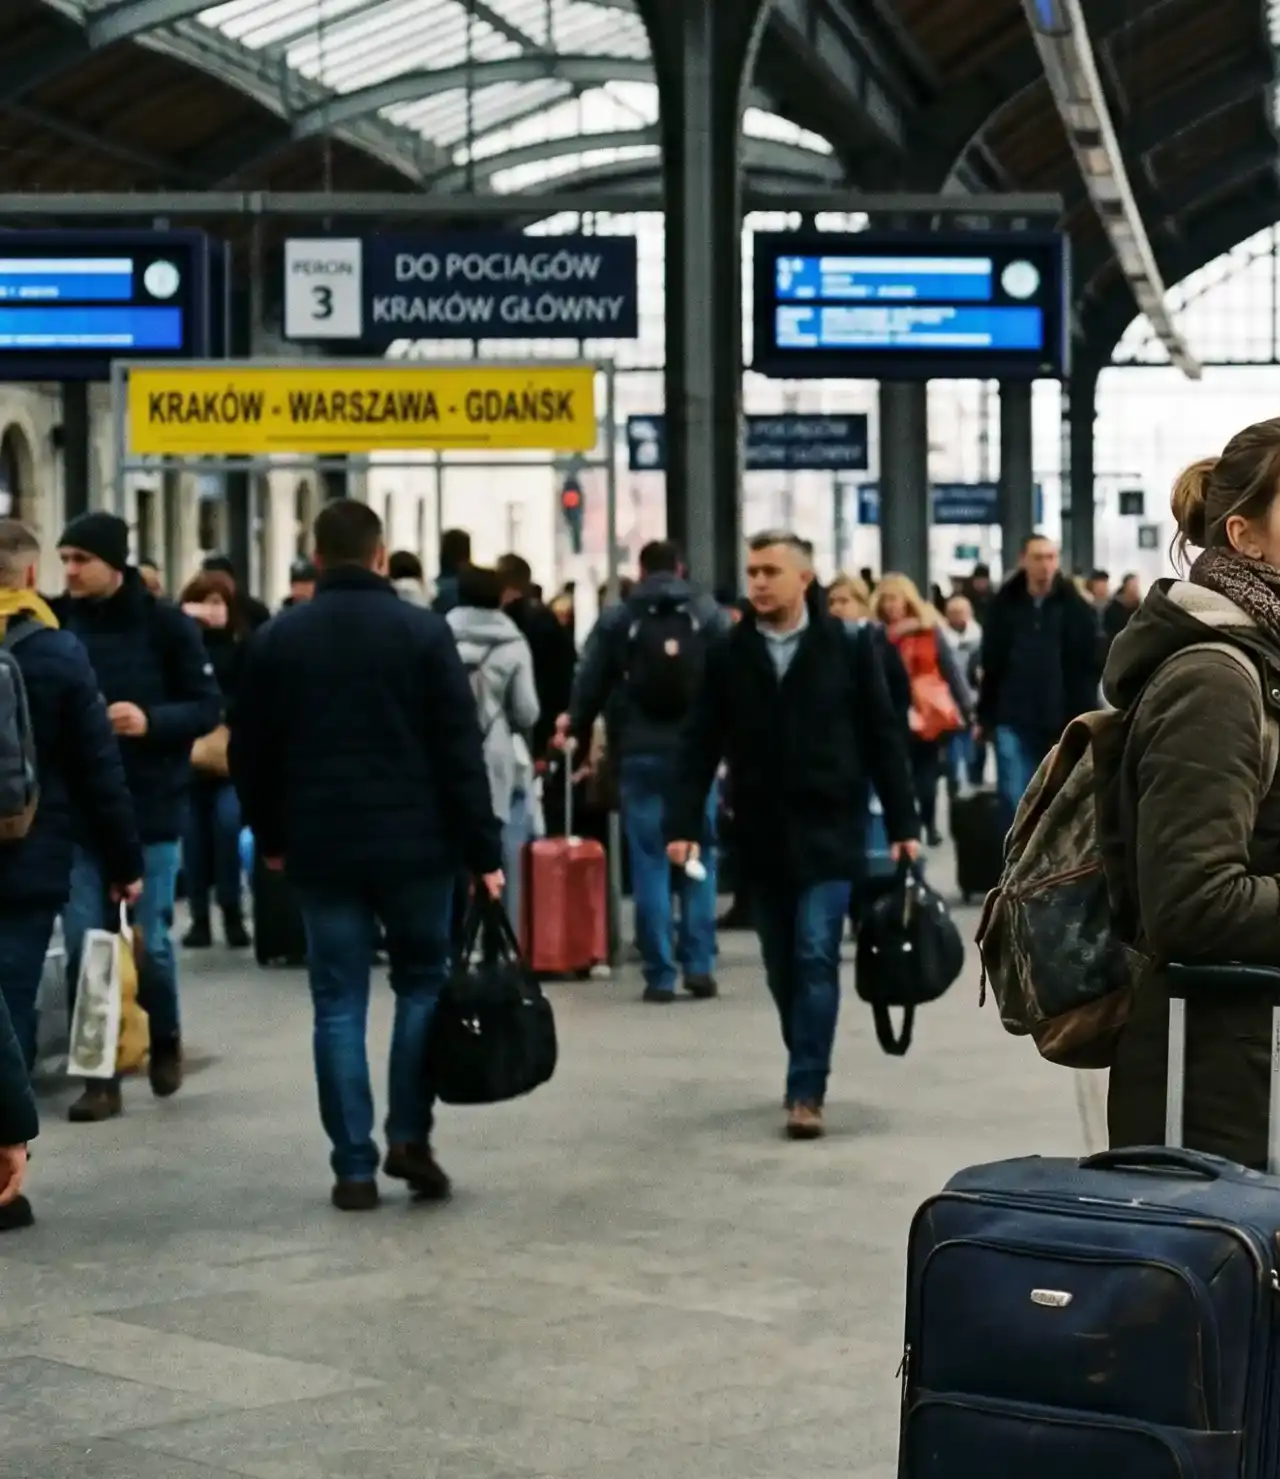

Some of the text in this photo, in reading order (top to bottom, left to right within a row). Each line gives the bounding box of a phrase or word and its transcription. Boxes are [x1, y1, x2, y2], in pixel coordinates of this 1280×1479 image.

[395, 250, 602, 285] DO POCIĄGÓW
[311, 285, 335, 320] 3
[372, 290, 495, 323] KRAKÓW
[148, 383, 264, 424] KRAKÓW
[288, 388, 440, 424] WARSZAWA
[465, 381, 575, 423] GDAŃSK
